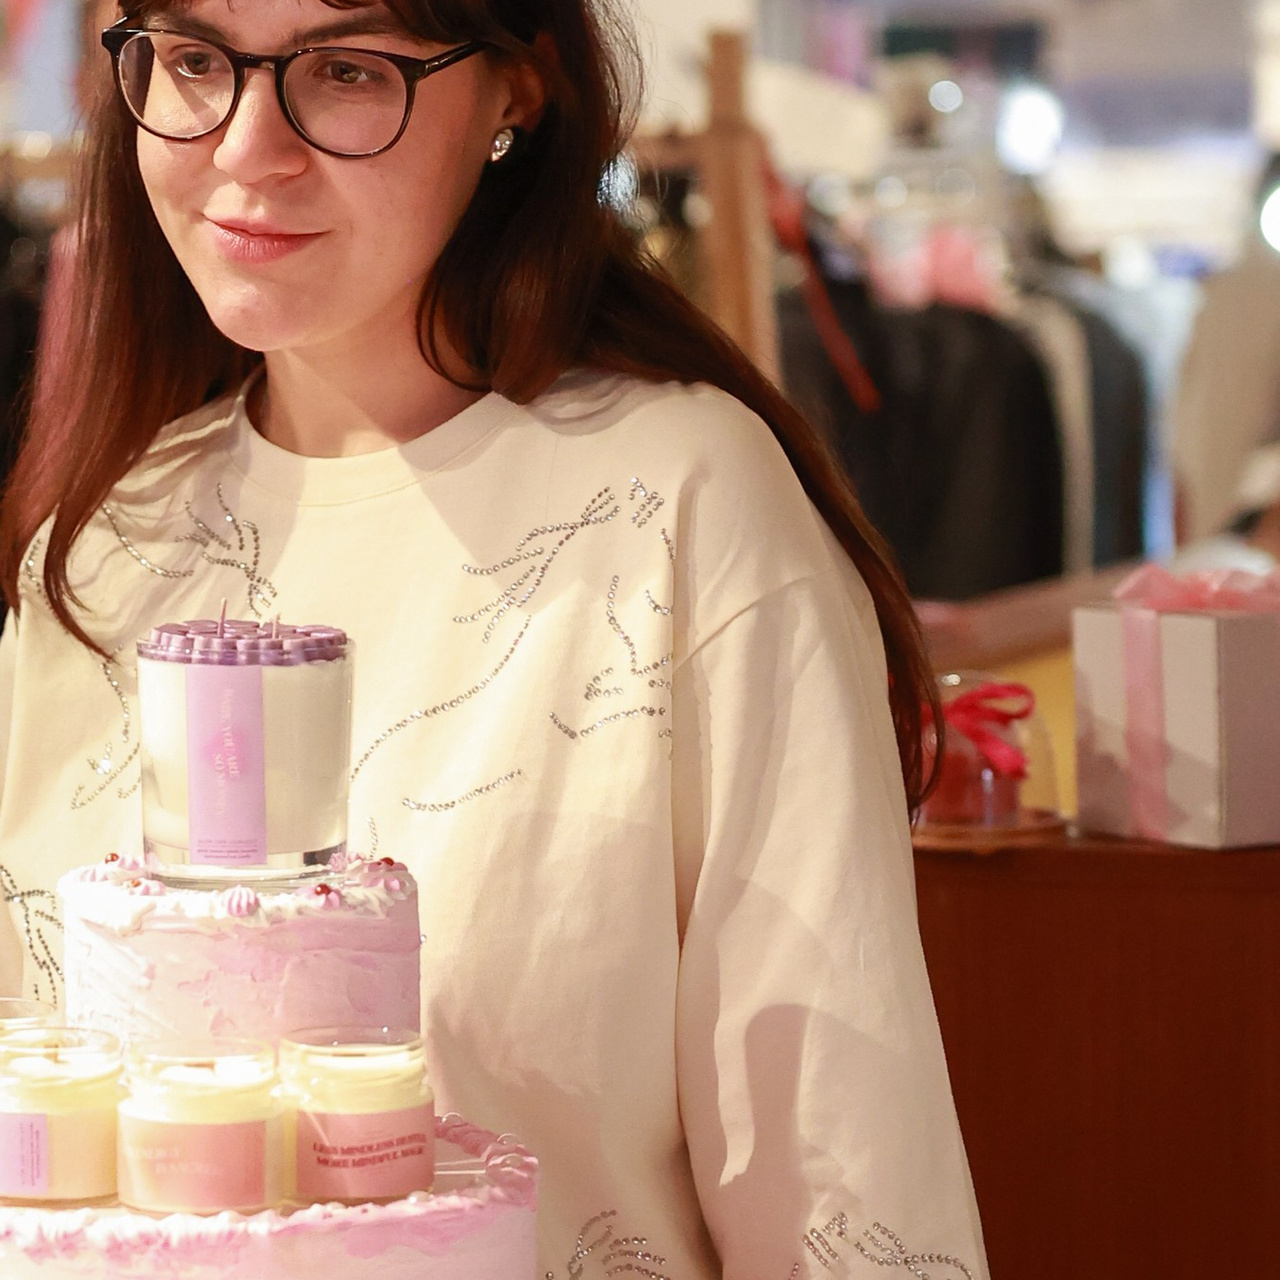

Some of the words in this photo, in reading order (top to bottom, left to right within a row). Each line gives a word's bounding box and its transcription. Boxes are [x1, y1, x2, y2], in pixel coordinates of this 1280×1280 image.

[222, 726, 236, 751] YOU
[214, 754, 225, 771] SO
[227, 754, 241, 779] ARE
[316, 1156, 349, 1168] MORE
